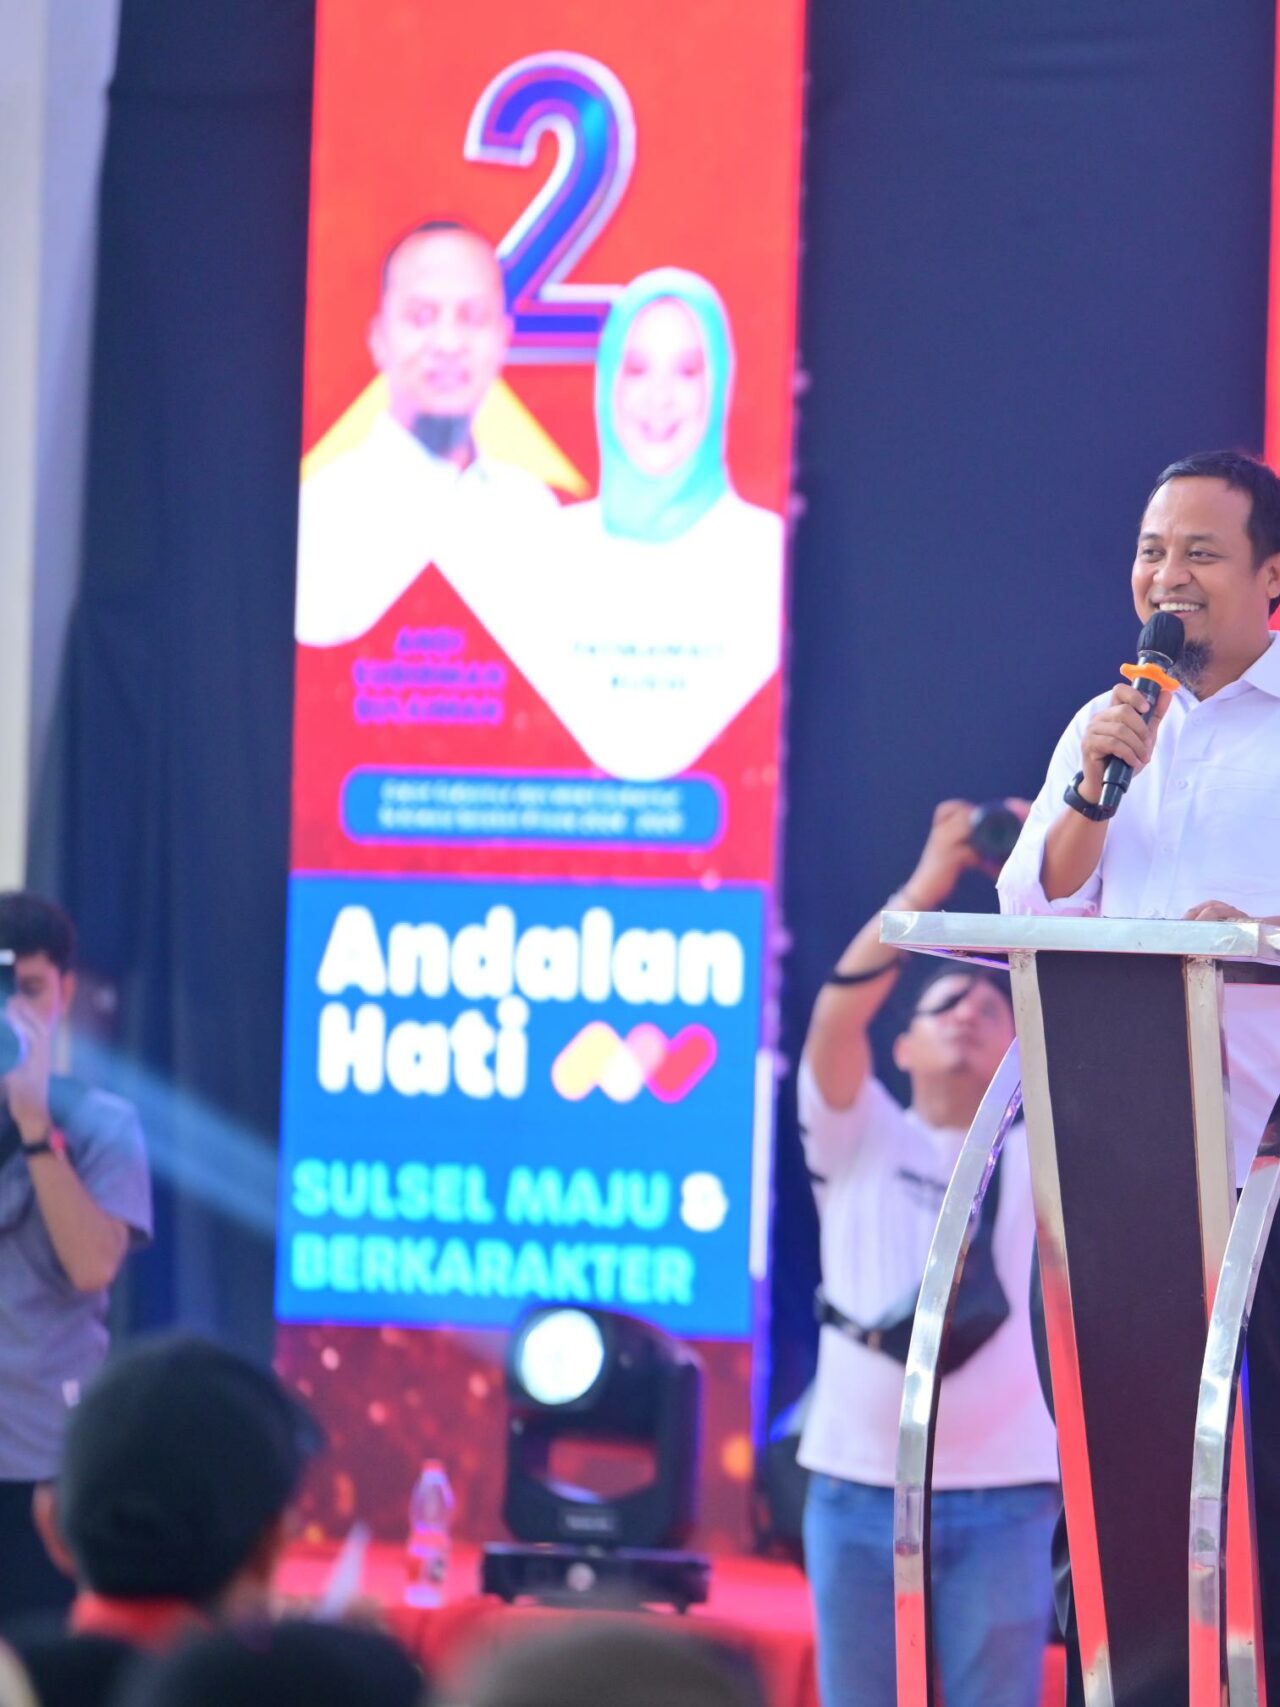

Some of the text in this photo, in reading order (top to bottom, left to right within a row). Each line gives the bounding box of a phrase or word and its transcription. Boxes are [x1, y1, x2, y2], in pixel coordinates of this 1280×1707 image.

[463, 49, 637, 366] 2
[316, 903, 745, 1007] Andalan
[317, 994, 530, 1100] Hati
[291, 1158, 494, 1224] SULSEL
[505, 1165, 671, 1231] MAJU
[290, 1231, 696, 1306] BERKARAKTER
